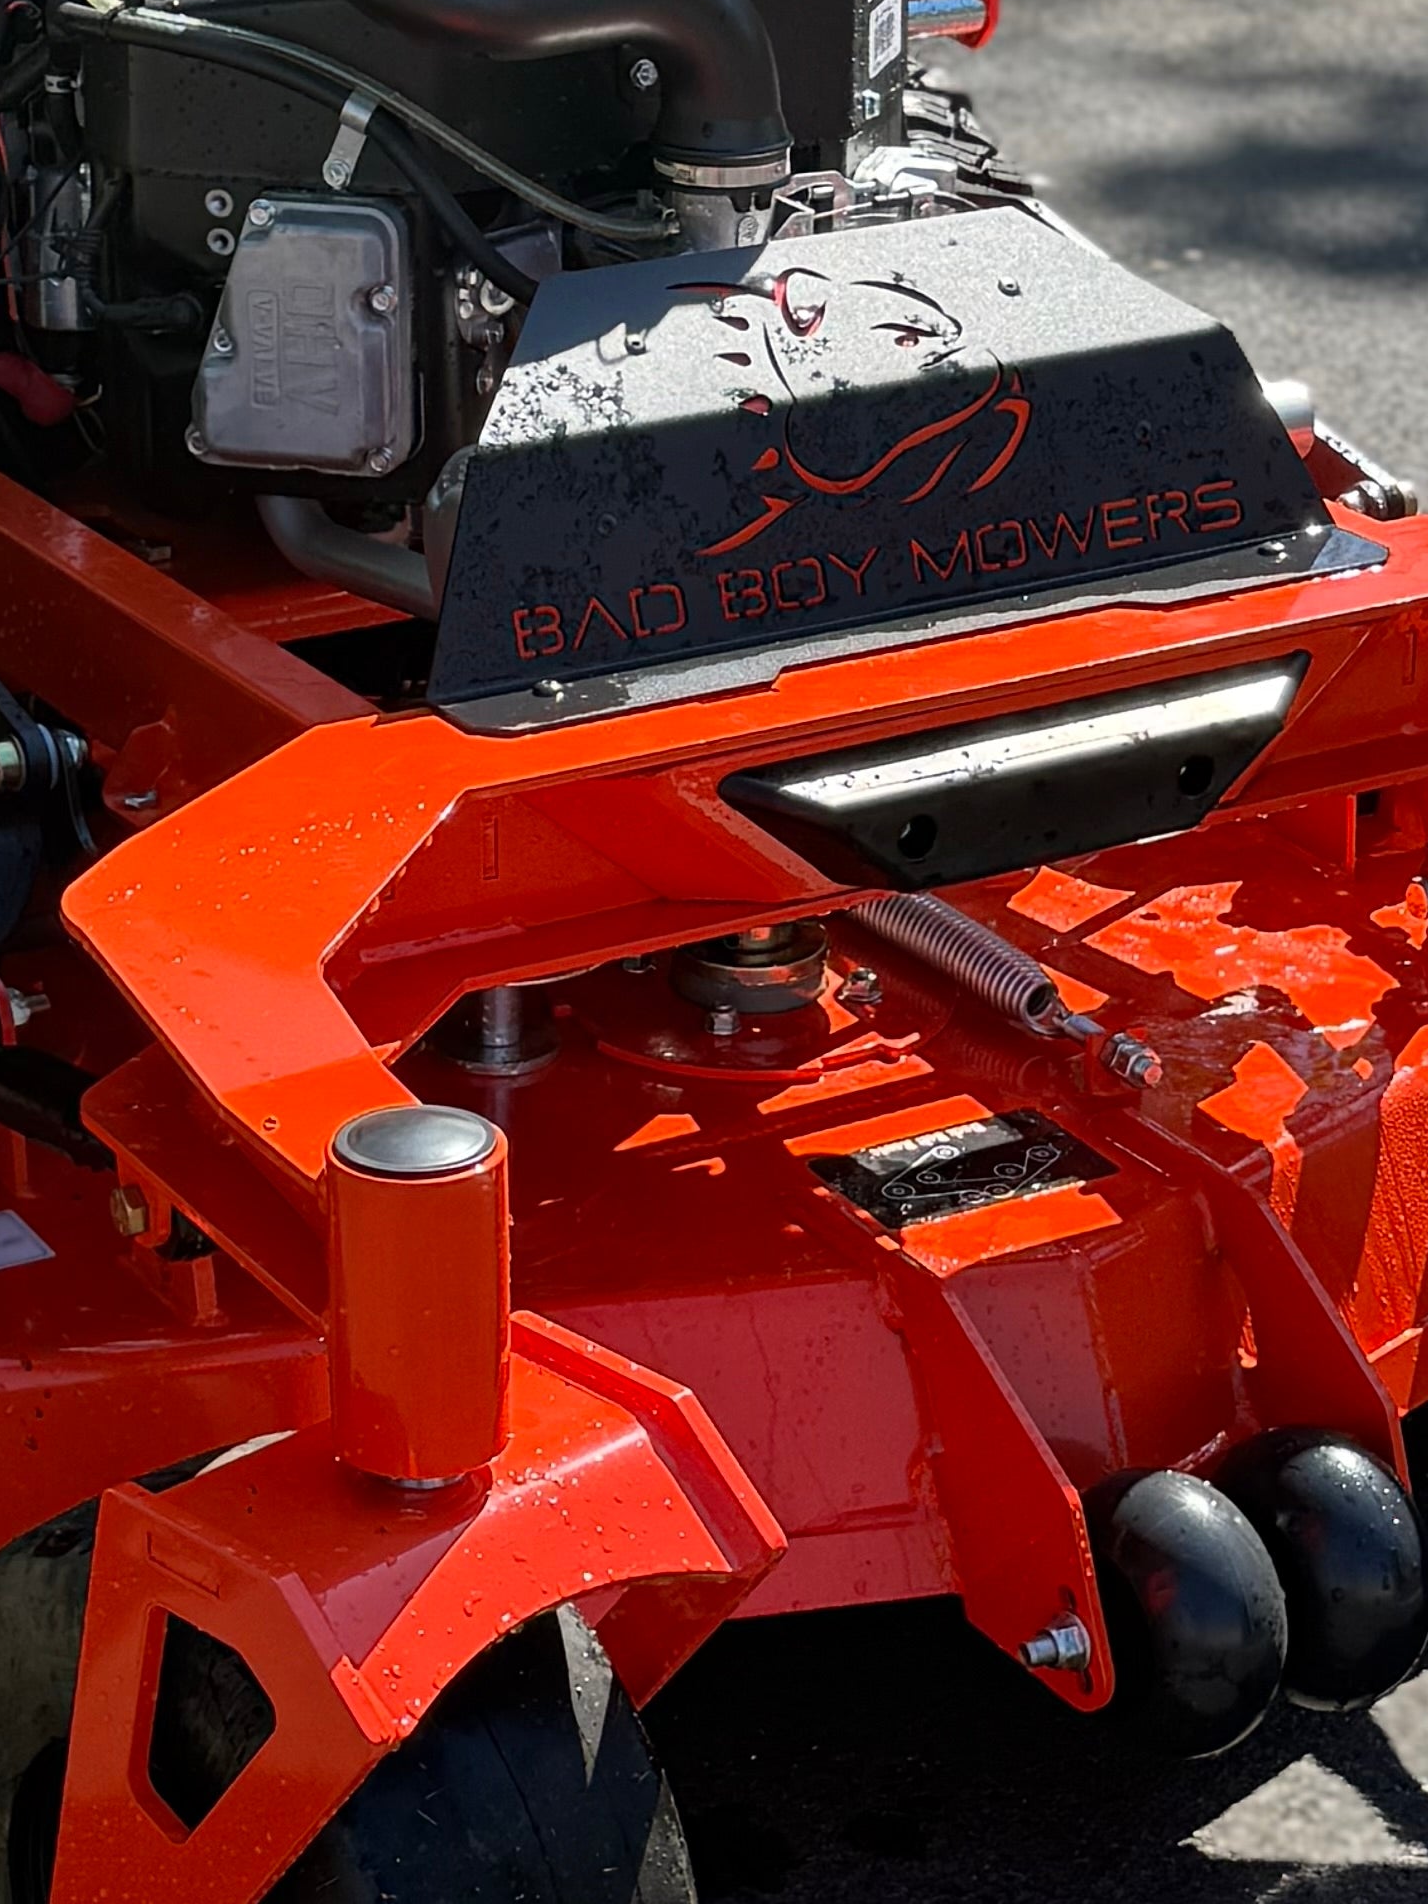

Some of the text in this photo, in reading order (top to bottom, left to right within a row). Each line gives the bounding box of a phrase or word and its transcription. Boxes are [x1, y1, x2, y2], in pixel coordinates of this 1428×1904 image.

[252, 298, 275, 406] V-VALVE
[511, 480, 1243, 659] BAD BOY MOWERS
